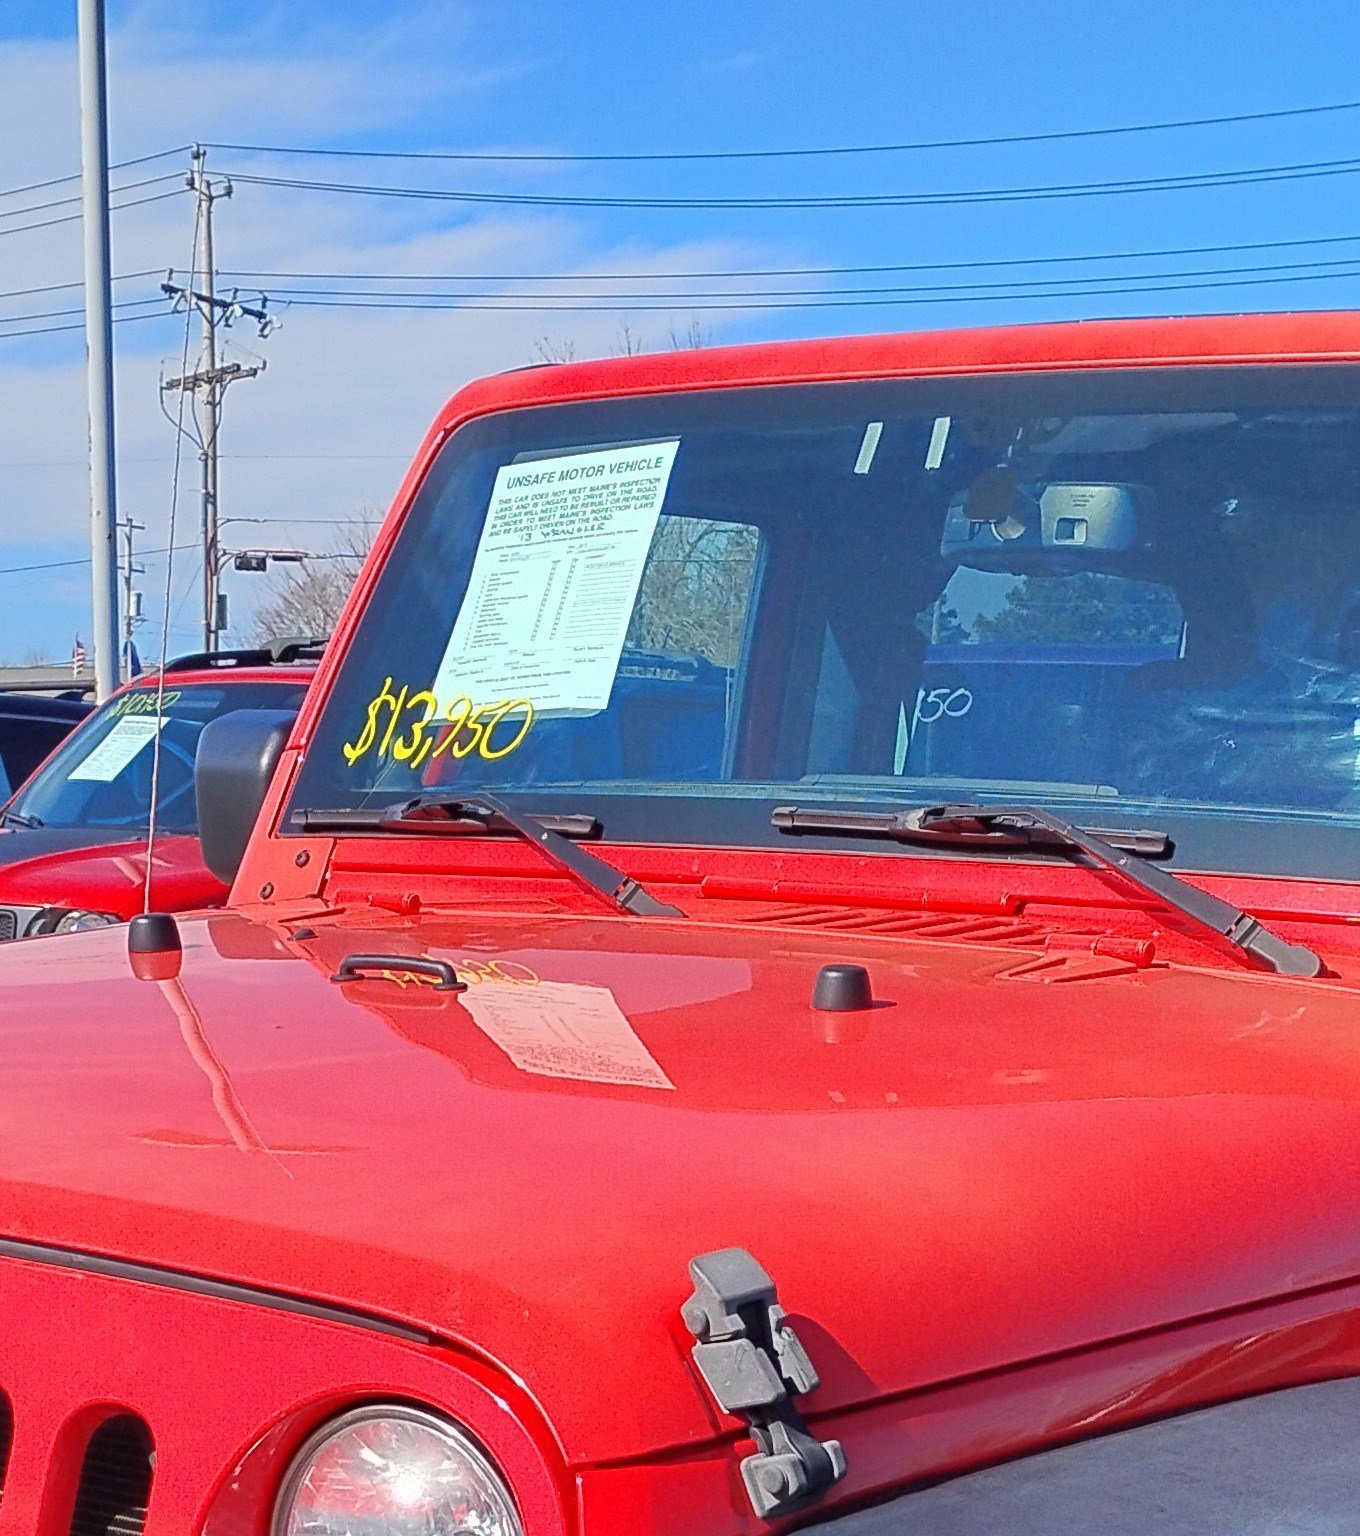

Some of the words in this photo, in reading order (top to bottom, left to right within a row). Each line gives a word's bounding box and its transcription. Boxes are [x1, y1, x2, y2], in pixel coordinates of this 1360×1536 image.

[506, 471, 556, 488] UNSAFE
[557, 464, 605, 481] MOTOR
[608, 456, 664, 474] VEHICLE
[343, 676, 534, 768] $13,950
